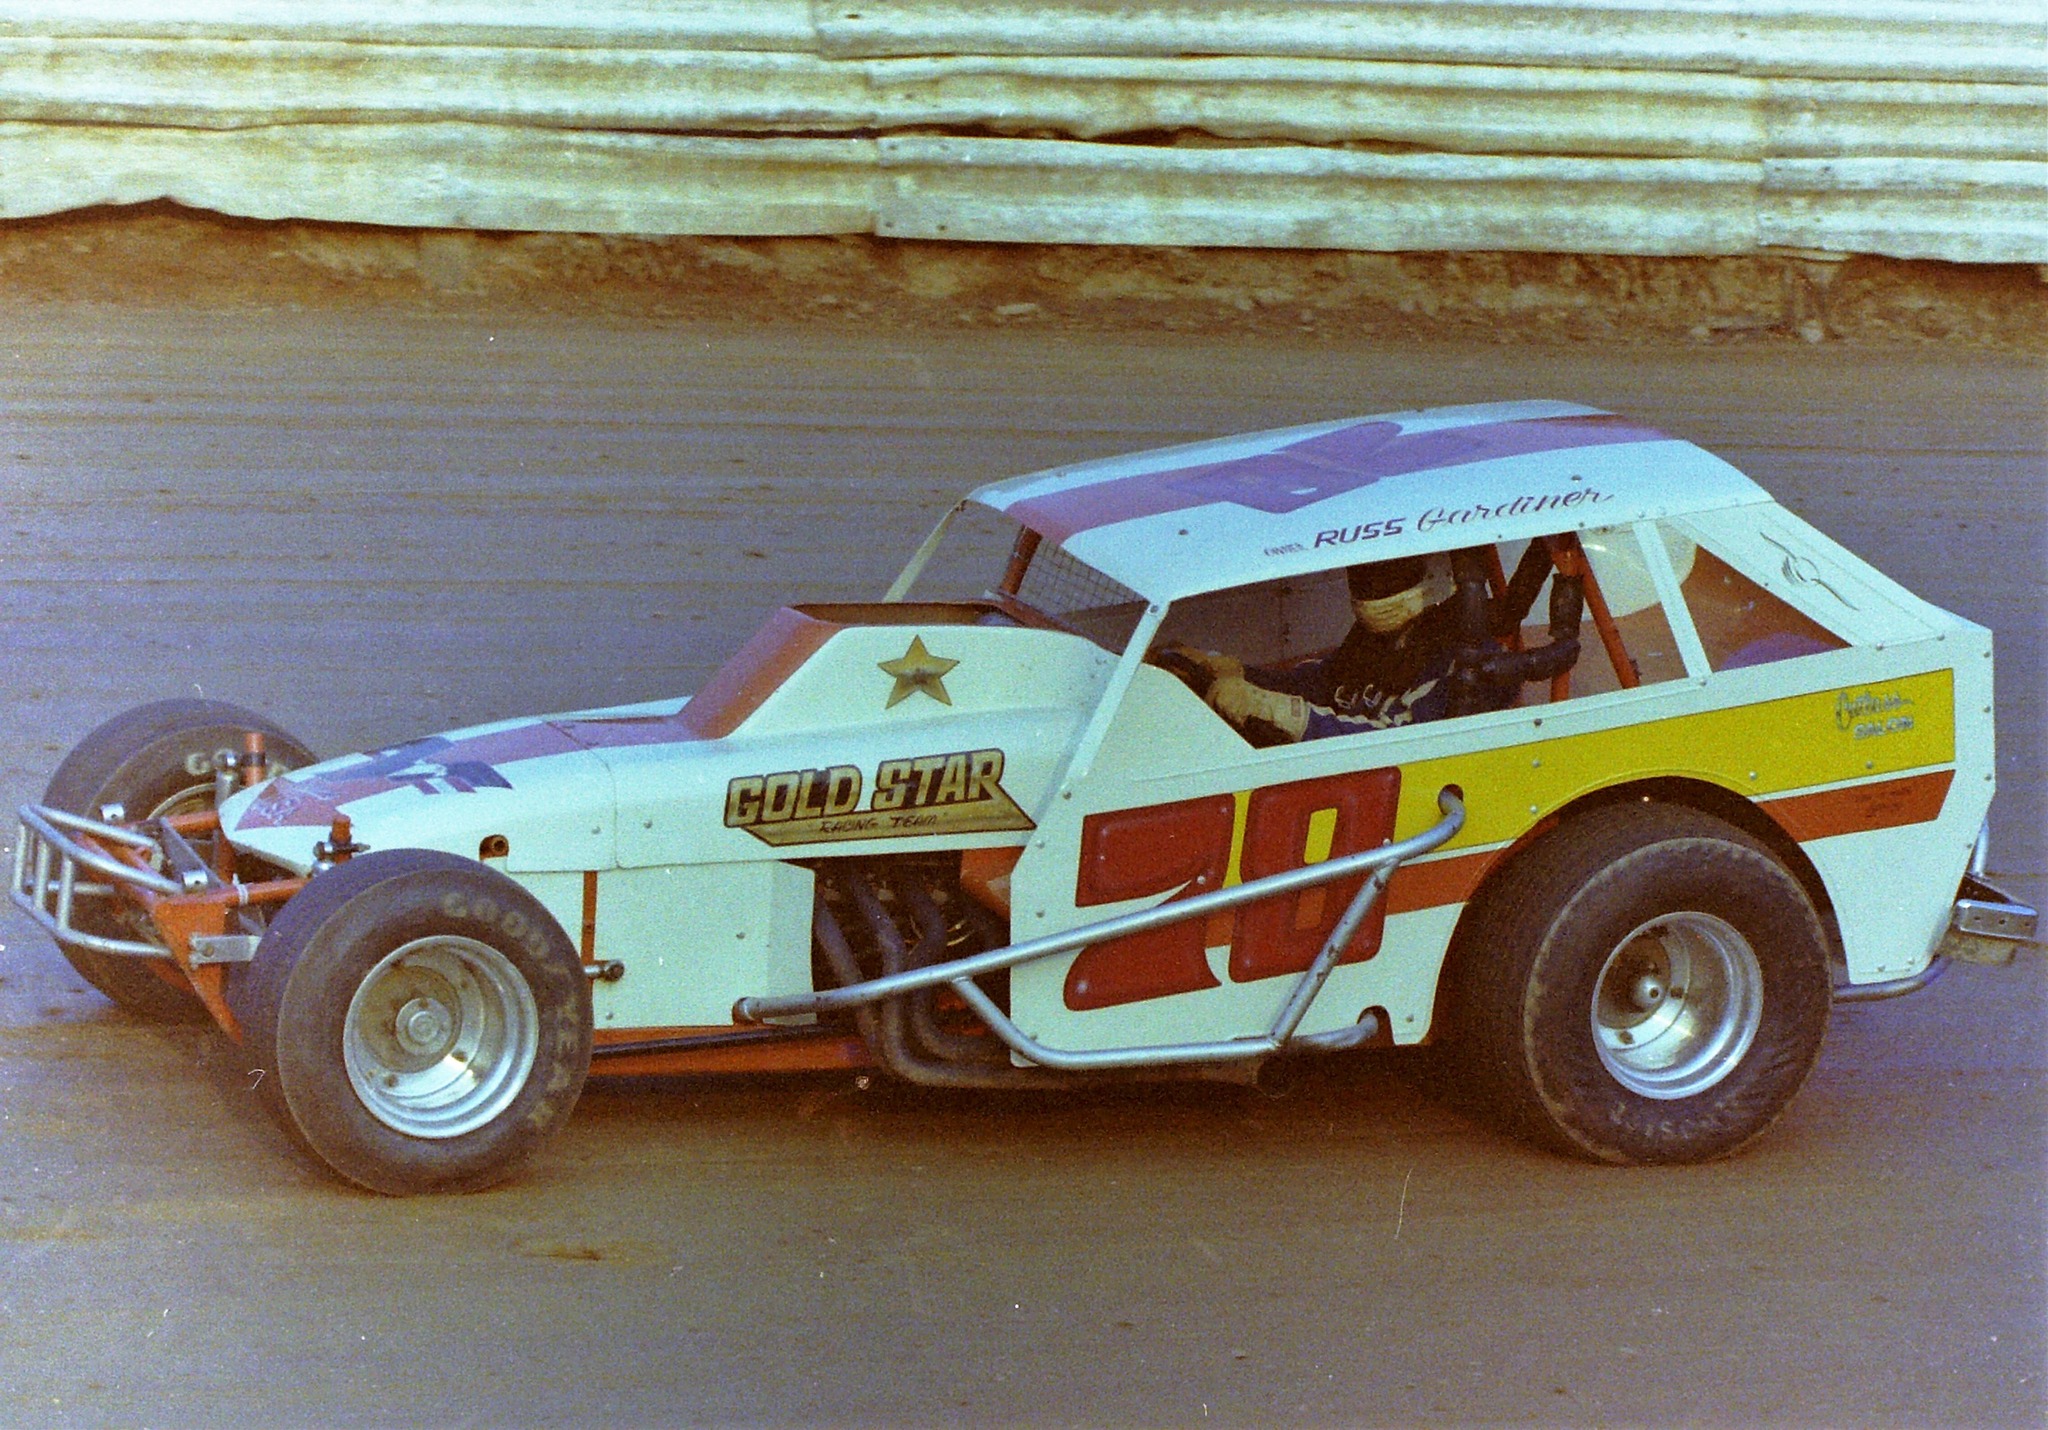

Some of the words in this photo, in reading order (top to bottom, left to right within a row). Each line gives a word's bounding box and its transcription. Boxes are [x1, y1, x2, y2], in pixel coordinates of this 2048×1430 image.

[1314, 517, 1405, 548] RUSS
[1416, 488, 1613, 532] Gardiner
[723, 765, 862, 828] GOLD
[871, 748, 1005, 812] STAR
[819, 817, 878, 833] RACING
[890, 814, 938, 829] TEAM
